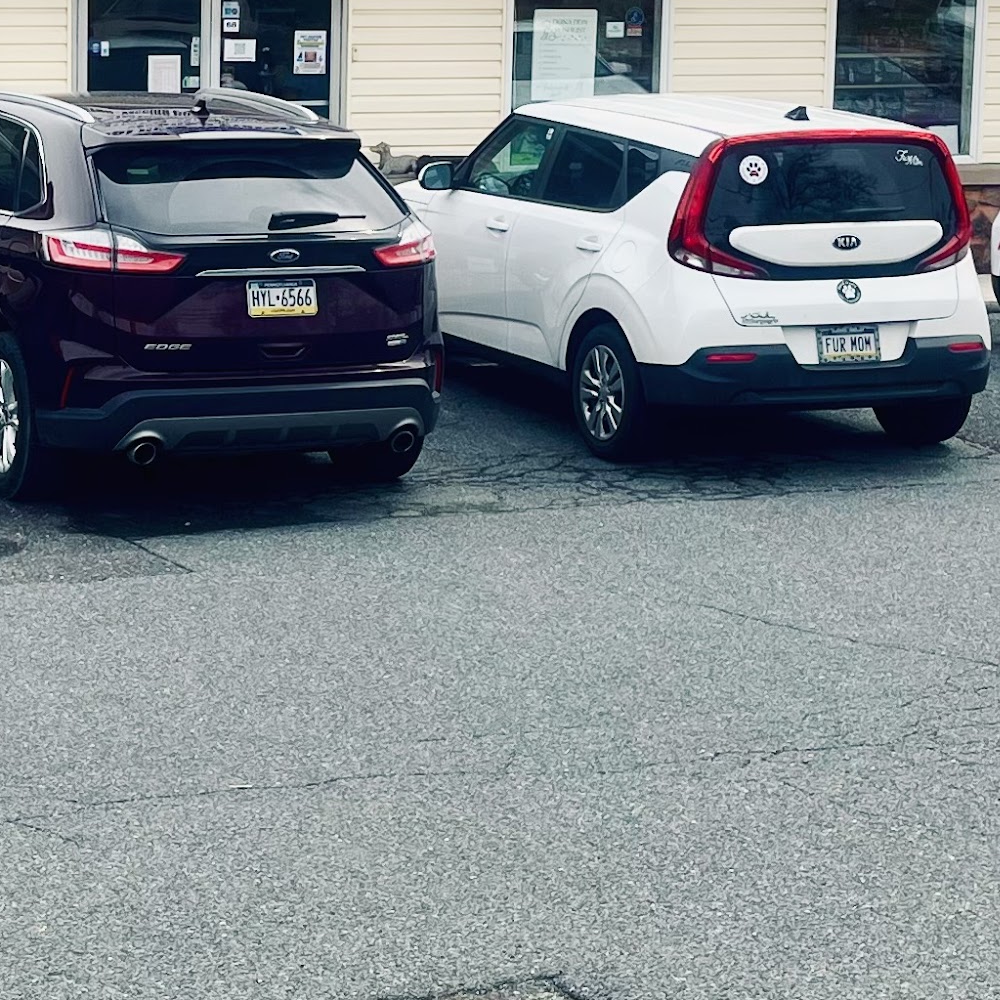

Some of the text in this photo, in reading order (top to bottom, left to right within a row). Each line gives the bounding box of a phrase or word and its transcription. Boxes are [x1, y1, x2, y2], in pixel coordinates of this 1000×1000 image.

[836, 236, 858, 248] KIA
[143, 343, 193, 351] EDGE
[825, 335, 873, 354] FUR MOM
